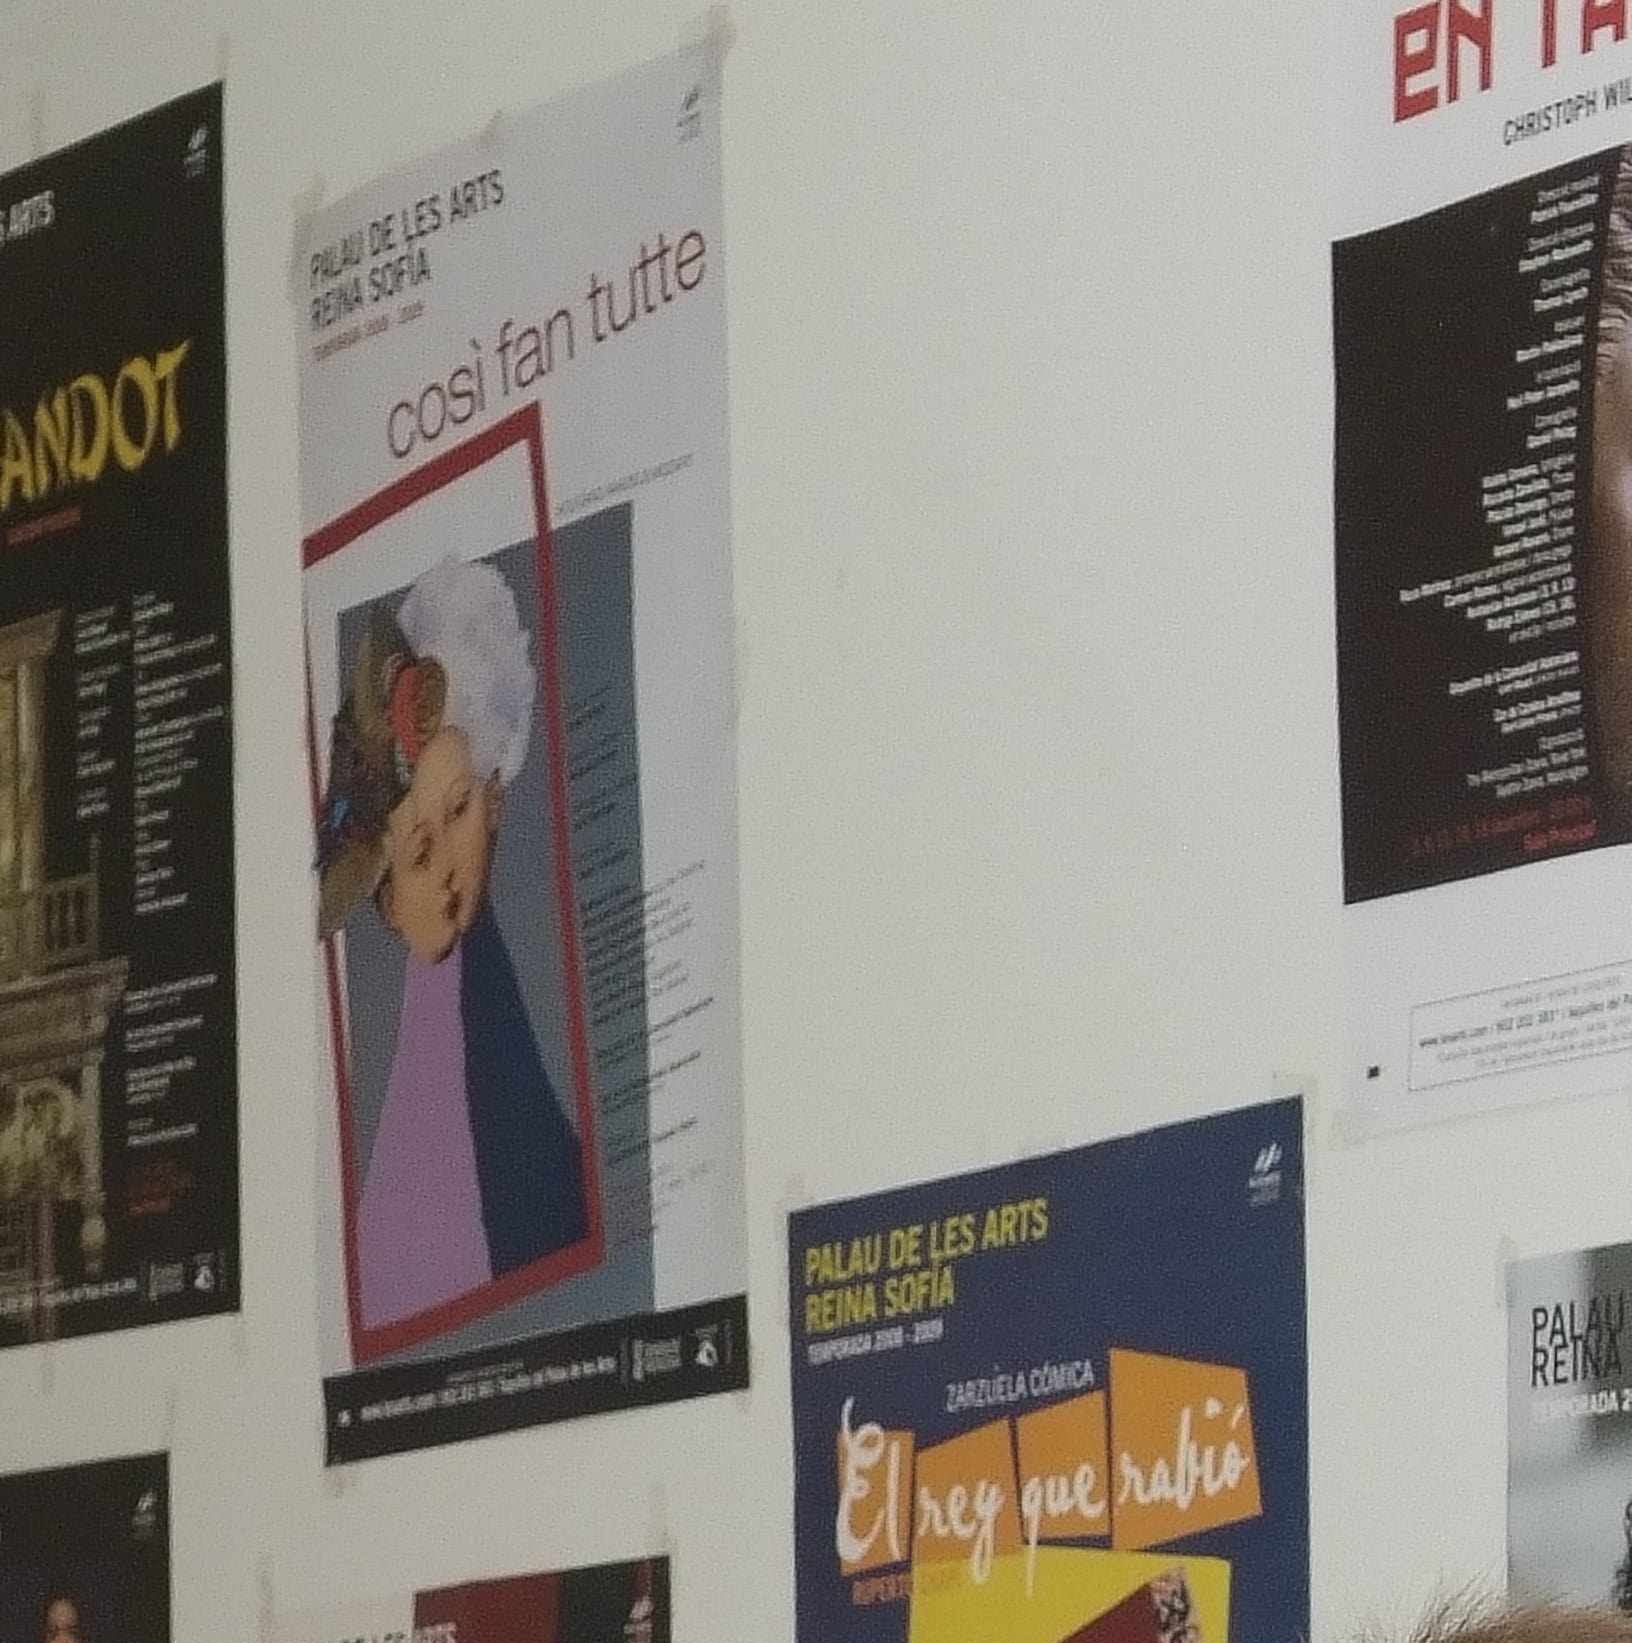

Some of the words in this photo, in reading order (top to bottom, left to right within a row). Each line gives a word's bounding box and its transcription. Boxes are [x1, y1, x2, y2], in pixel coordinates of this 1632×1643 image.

[1503, 89, 1597, 146] CHRISTOPH
[369, 213, 396, 256] DE
[402, 194, 441, 242] LES
[451, 169, 504, 224] ARTS
[388, 338, 485, 458] così
[497, 309, 574, 396] fan
[588, 230, 706, 342] tutte
[806, 1232, 881, 1286] PALAU
[890, 1224, 923, 1269] DE
[930, 1214, 976, 1260] LES
[982, 1198, 1049, 1250] ARTS
[806, 1282, 877, 1334] REINA
[1531, 1294, 1626, 1348] PALAU
[1531, 1329, 1622, 1388] REINA
[834, 1396, 901, 1564] El
[916, 1478, 1006, 1584] rey
[1021, 1463, 1108, 1598] que
[1117, 1397, 1250, 1511] rabió
